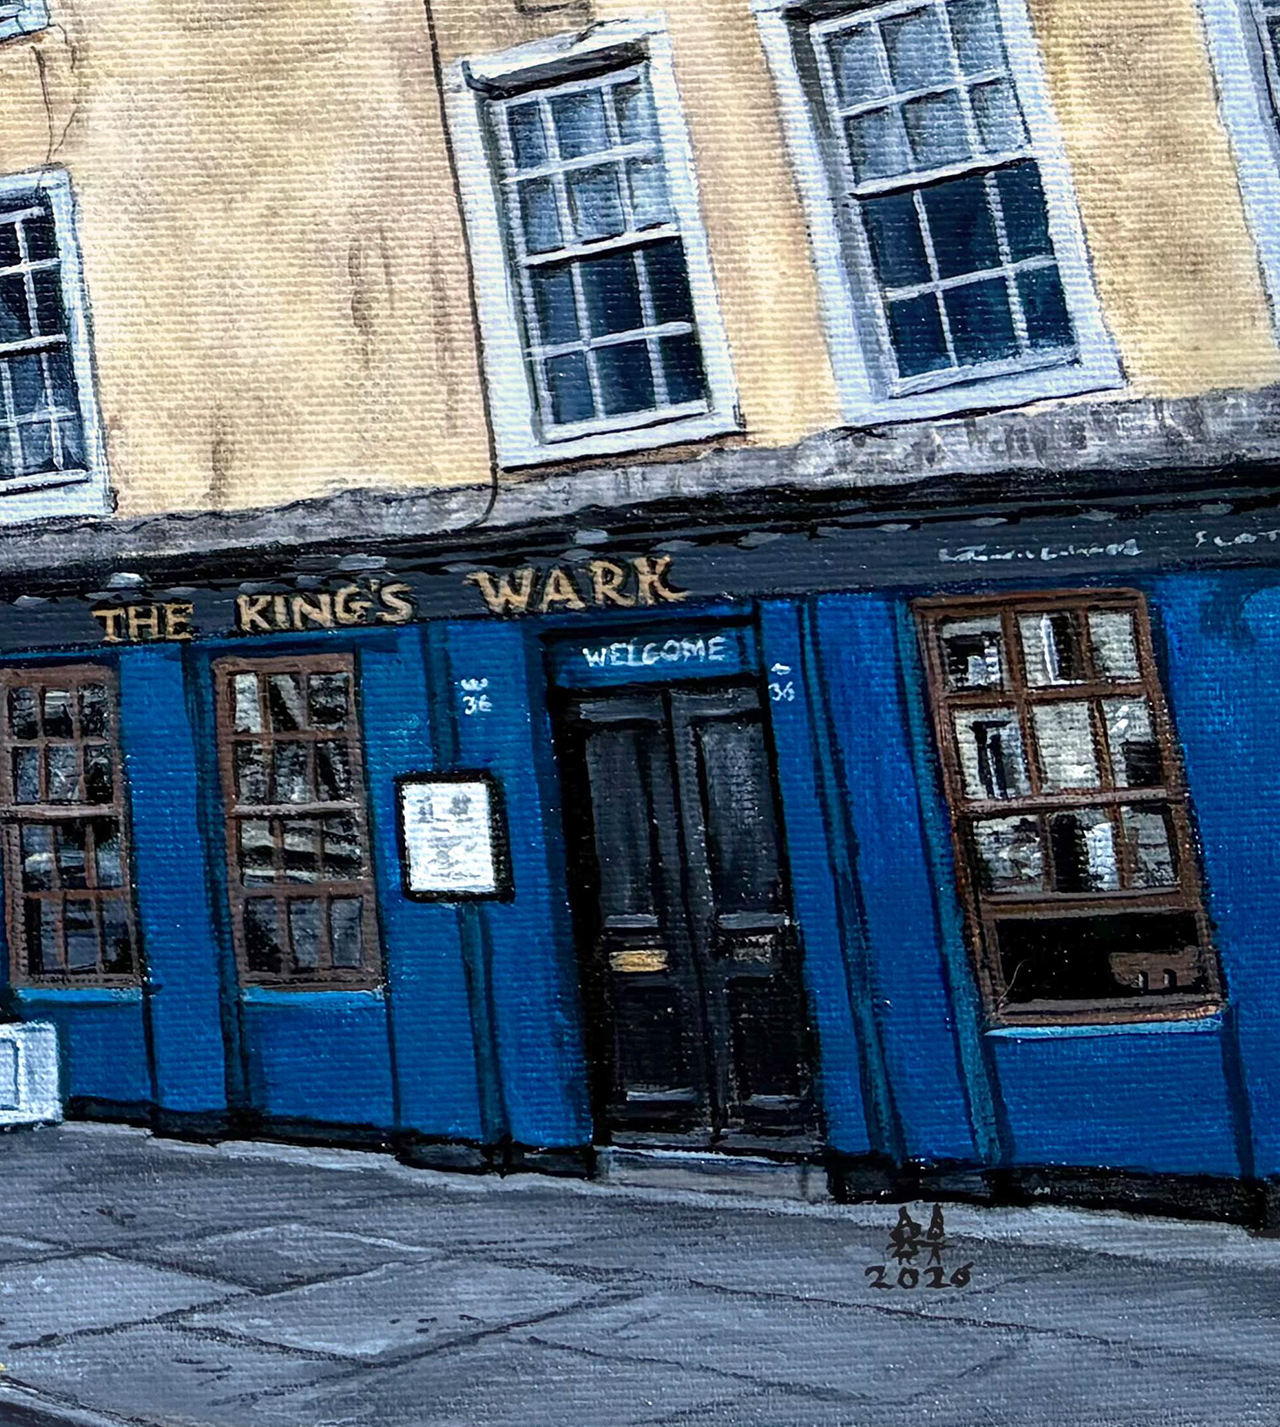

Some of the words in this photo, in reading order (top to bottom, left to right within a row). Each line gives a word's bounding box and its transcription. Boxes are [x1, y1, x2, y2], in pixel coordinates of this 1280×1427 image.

[92, 601, 193, 643] THE
[234, 578, 415, 632] KING'S
[461, 554, 691, 614] WARK
[582, 635, 727, 668] WELCOME
[767, 680, 795, 702] 36
